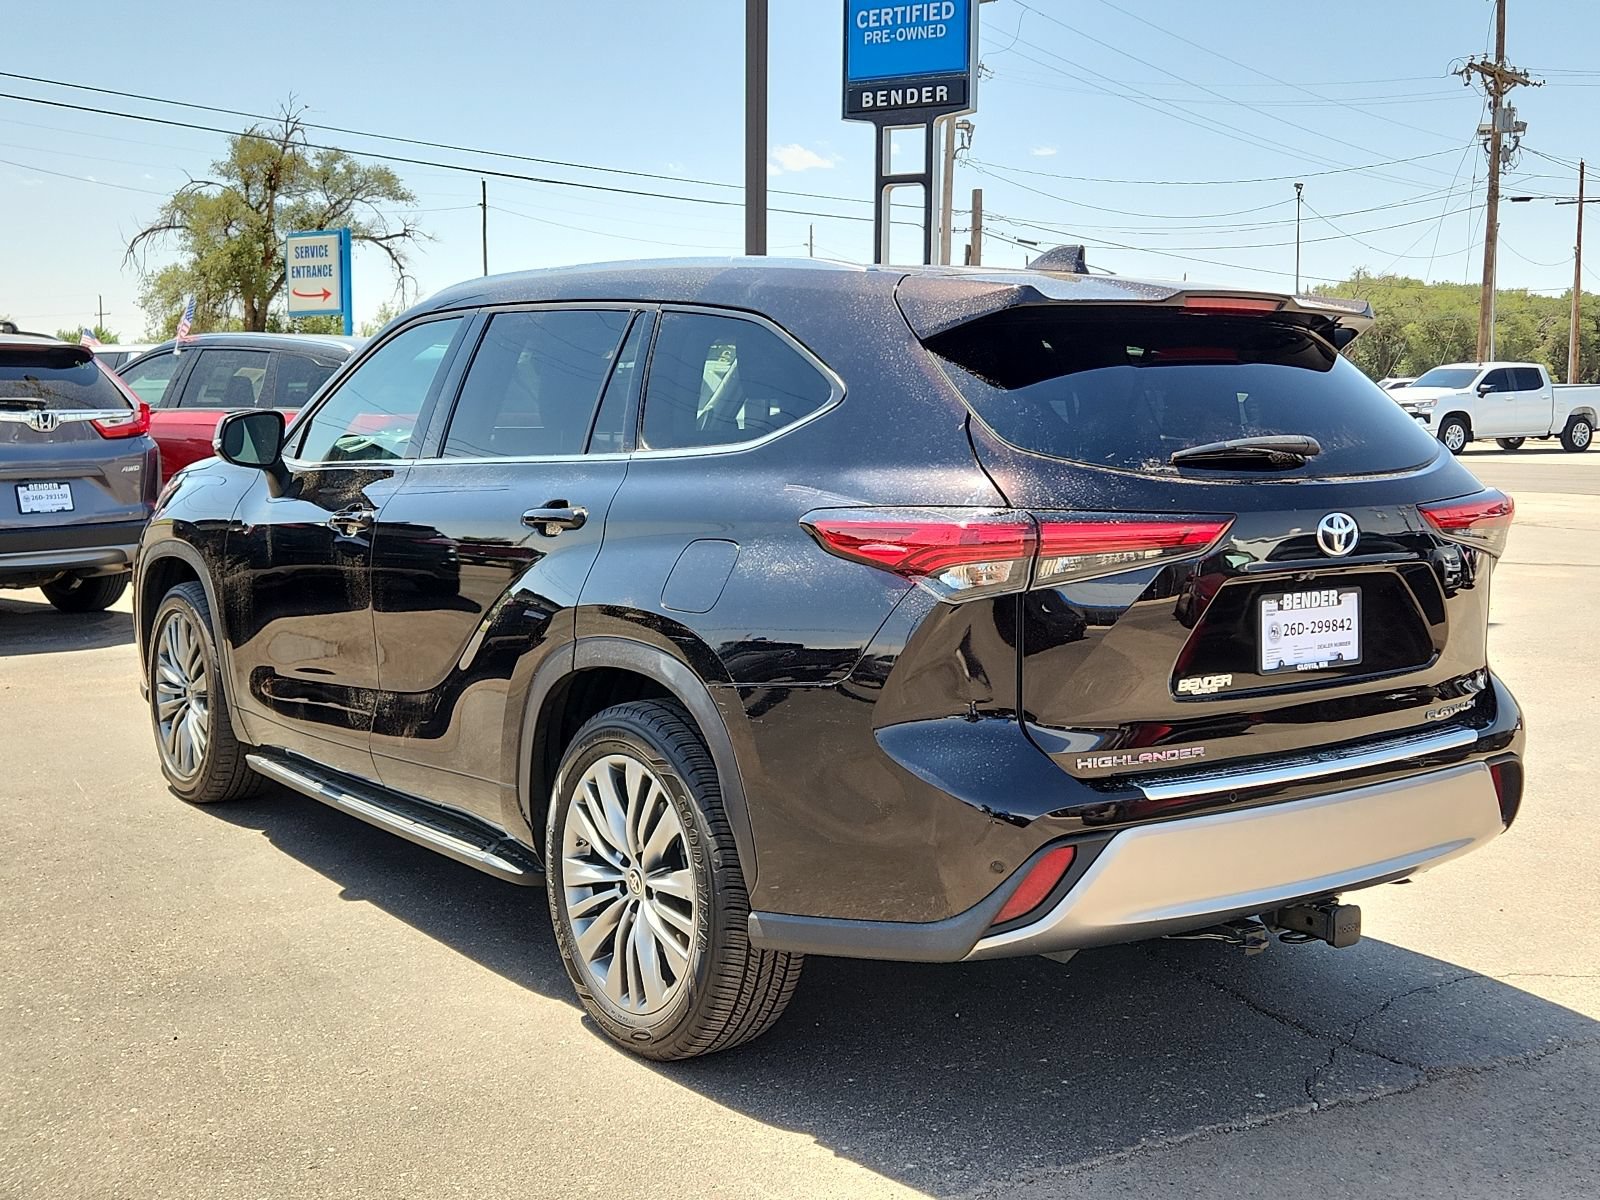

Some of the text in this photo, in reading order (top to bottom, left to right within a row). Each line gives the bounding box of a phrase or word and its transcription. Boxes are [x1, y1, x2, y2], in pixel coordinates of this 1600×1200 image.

[856, 1, 955, 28] CERTIFIED
[864, 24, 946, 45] PRE-OWNED
[861, 85, 948, 108] BENDER
[294, 244, 328, 259] SERVICE
[291, 264, 333, 279] ENTRANCE
[121, 464, 140, 473] AWD
[28, 483, 59, 491] BENDER
[1282, 589, 1338, 610] BENDER
[1283, 617, 1352, 637] 26D-299842
[1177, 674, 1232, 692] BENDER
[1076, 746, 1205, 770] HIGHLANDER
